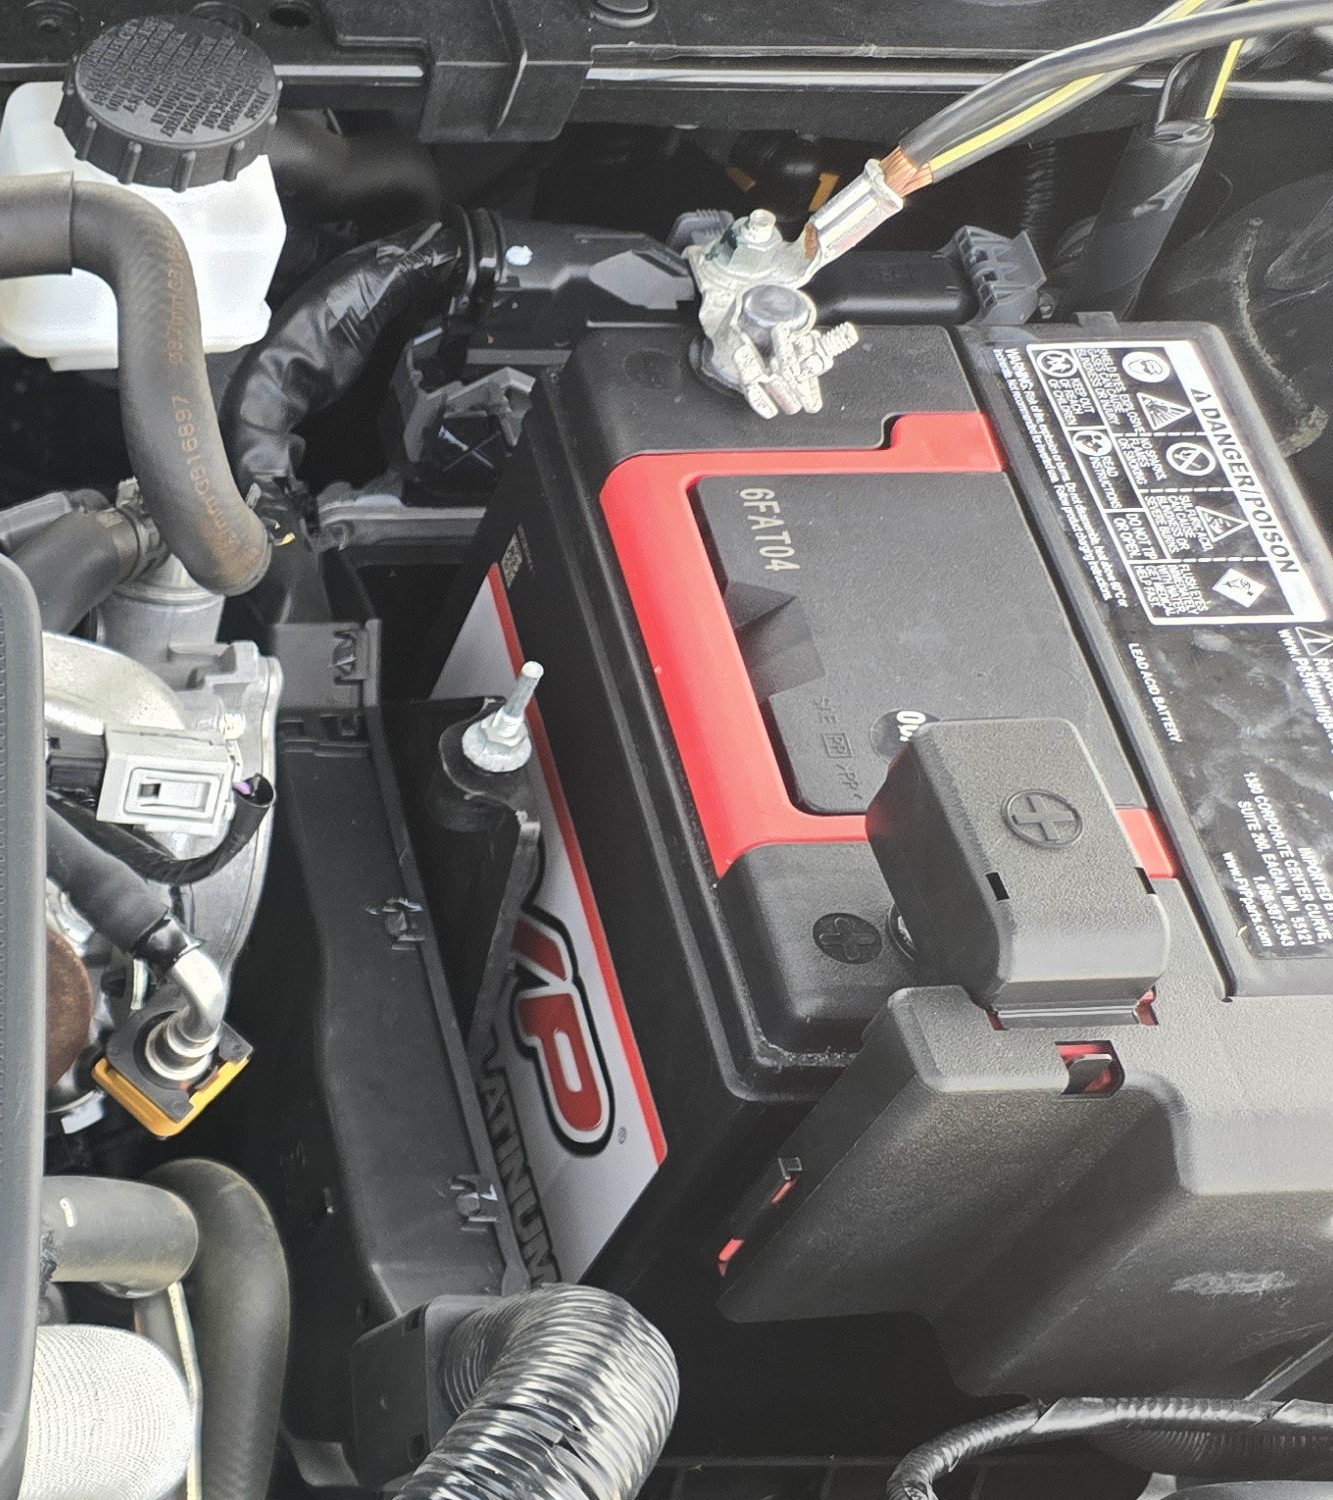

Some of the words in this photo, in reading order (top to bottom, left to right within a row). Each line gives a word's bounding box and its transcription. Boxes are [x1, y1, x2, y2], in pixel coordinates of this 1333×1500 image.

[1046, 378, 1060, 389] OF
[1058, 379, 1071, 388] OF
[1063, 390, 1084, 414] REACH
[1069, 378, 1087, 396] KEEP
[1079, 398, 1095, 413] OUT
[1094, 388, 1108, 399] OR
[1117, 438, 1131, 449] OR
[1139, 437, 1153, 448] NO
[1099, 455, 1119, 476] READ
[1198, 407, 1298, 573] DANGER/POISON
[1166, 495, 1183, 511] CAN
[1111, 518, 1129, 530] OR
[1124, 513, 1142, 526] DO
[1154, 495, 1184, 536] BLINDNESS
[1175, 538, 1190, 549] OR
[1174, 512, 1196, 538] CAUSE
[740, 488, 800, 571] 6FAT04
[1131, 527, 1151, 545] NOT
[1140, 546, 1157, 559] TIP
[1127, 641, 1150, 670] LEAD
[1140, 669, 1161, 695] ACID
[1151, 695, 1183, 743] BATTERY
[1238, 800, 1259, 830] SUITE
[1259, 852, 1290, 893] EAGAN,
[1279, 894, 1299, 911] MN
[1255, 796, 1294, 861] CORPORATE
[1282, 858, 1315, 901] CENTER
